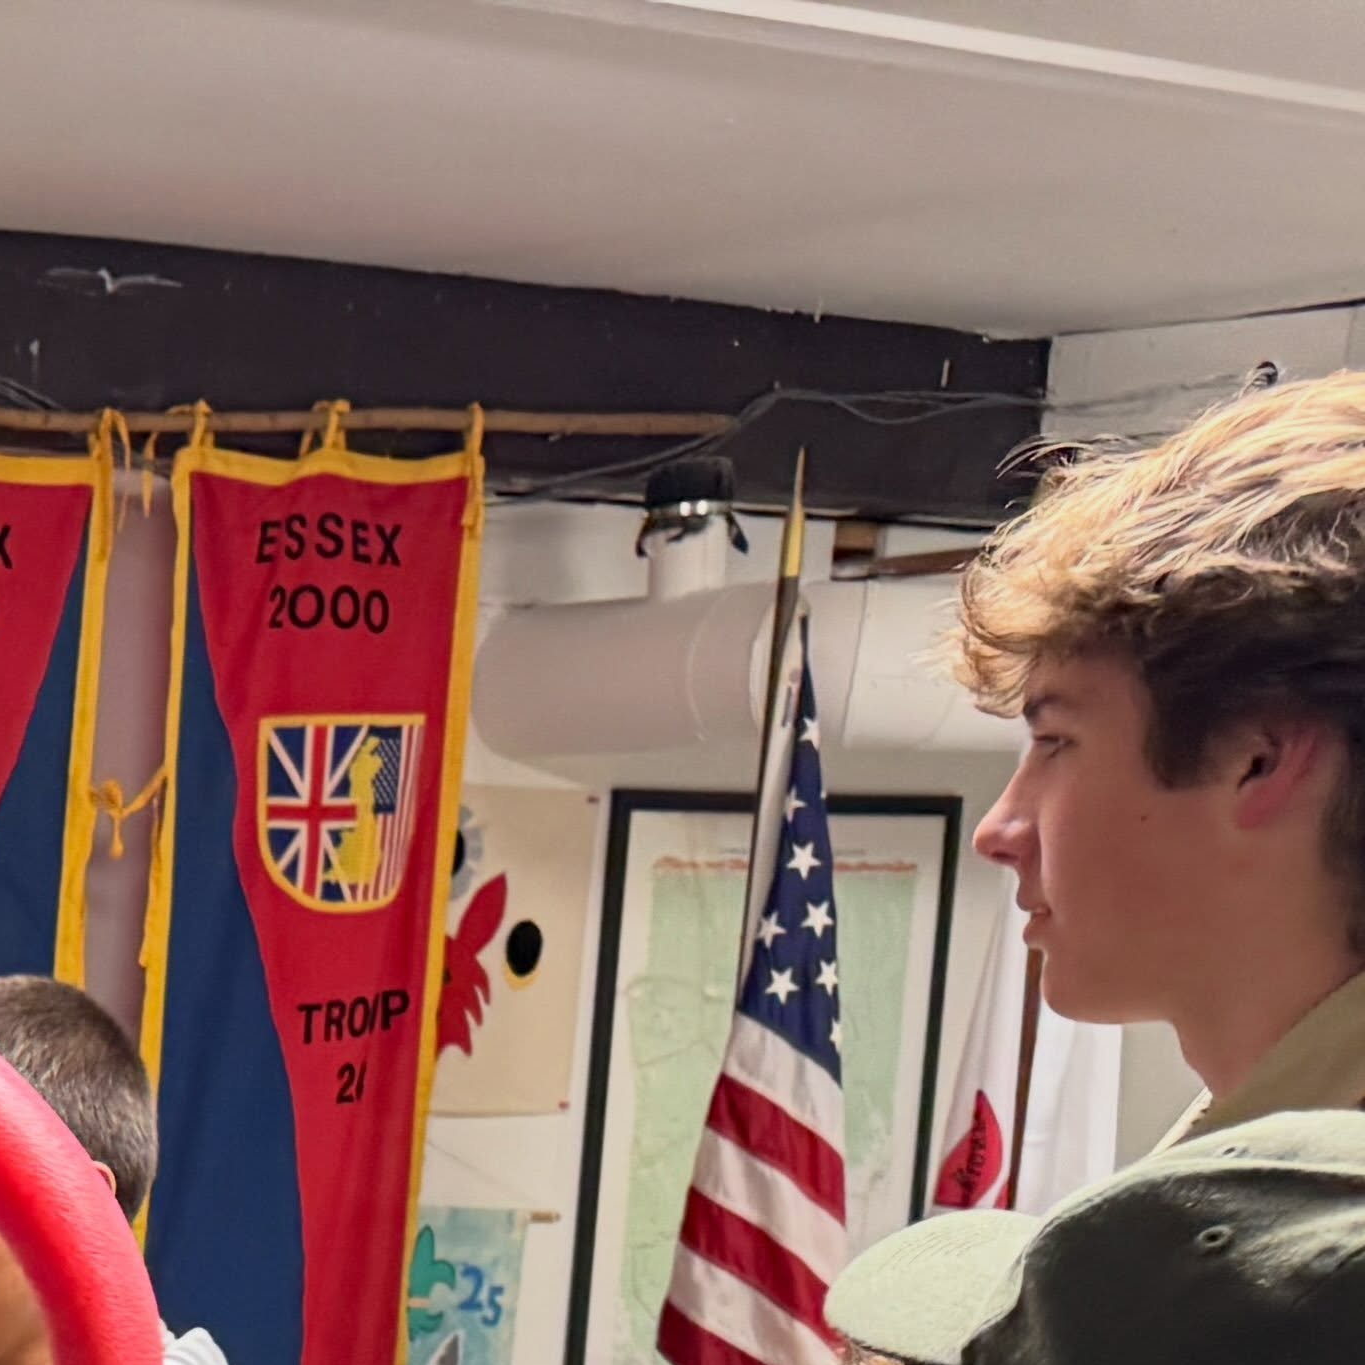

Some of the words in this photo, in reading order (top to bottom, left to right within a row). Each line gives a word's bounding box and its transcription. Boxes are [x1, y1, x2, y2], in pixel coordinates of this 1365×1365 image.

[255, 512, 402, 567] ESSEX
[269, 584, 390, 635] 2000
[458, 1264, 505, 1328] 25
